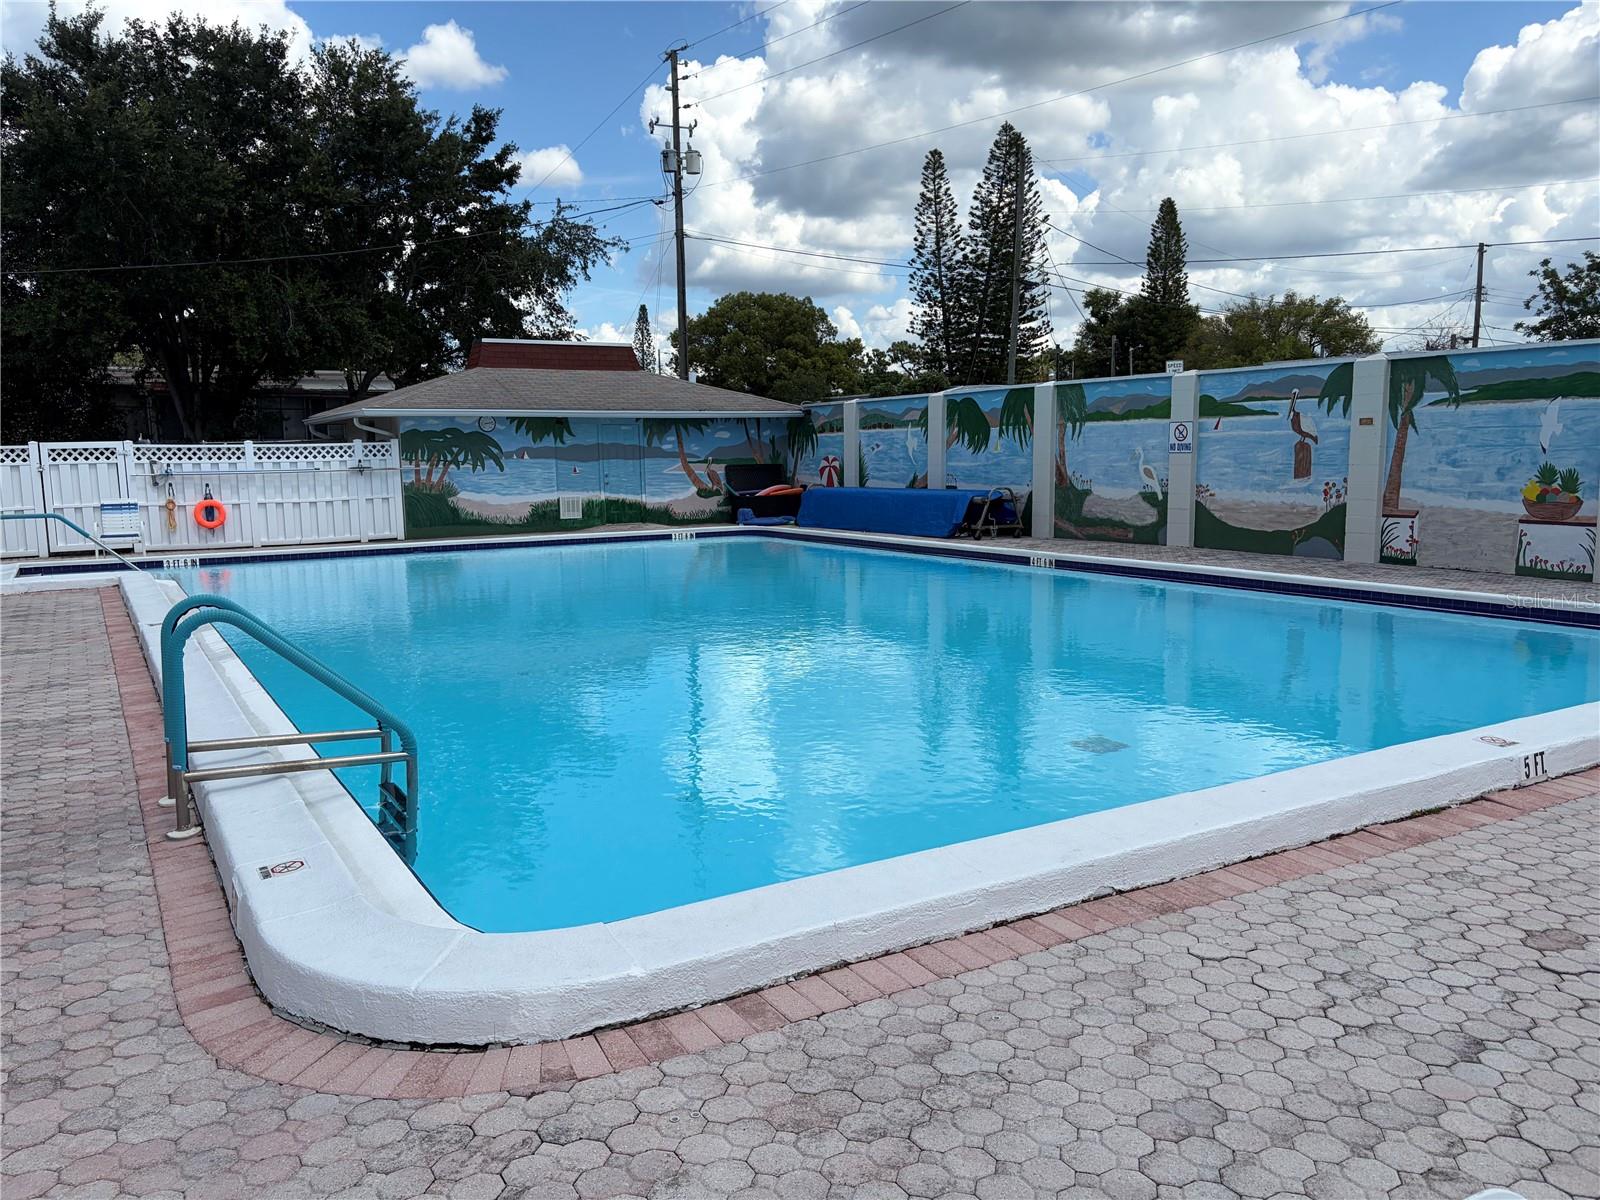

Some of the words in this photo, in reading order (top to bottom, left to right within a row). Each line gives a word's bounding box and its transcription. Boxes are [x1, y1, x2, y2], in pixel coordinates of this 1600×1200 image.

[1170, 443, 1176, 451] NO
[1177, 443, 1191, 451] DIVING
[166, 560, 170, 569] 3
[172, 560, 180, 568] FT
[184, 558, 188, 568] 6
[190, 558, 198, 568] IN
[1032, 557, 1035, 565] 4
[1036, 558, 1042, 567] FT
[1049, 558, 1054, 568] IN
[1524, 756, 1530, 779] 5
[1534, 751, 1548, 776] FT.
